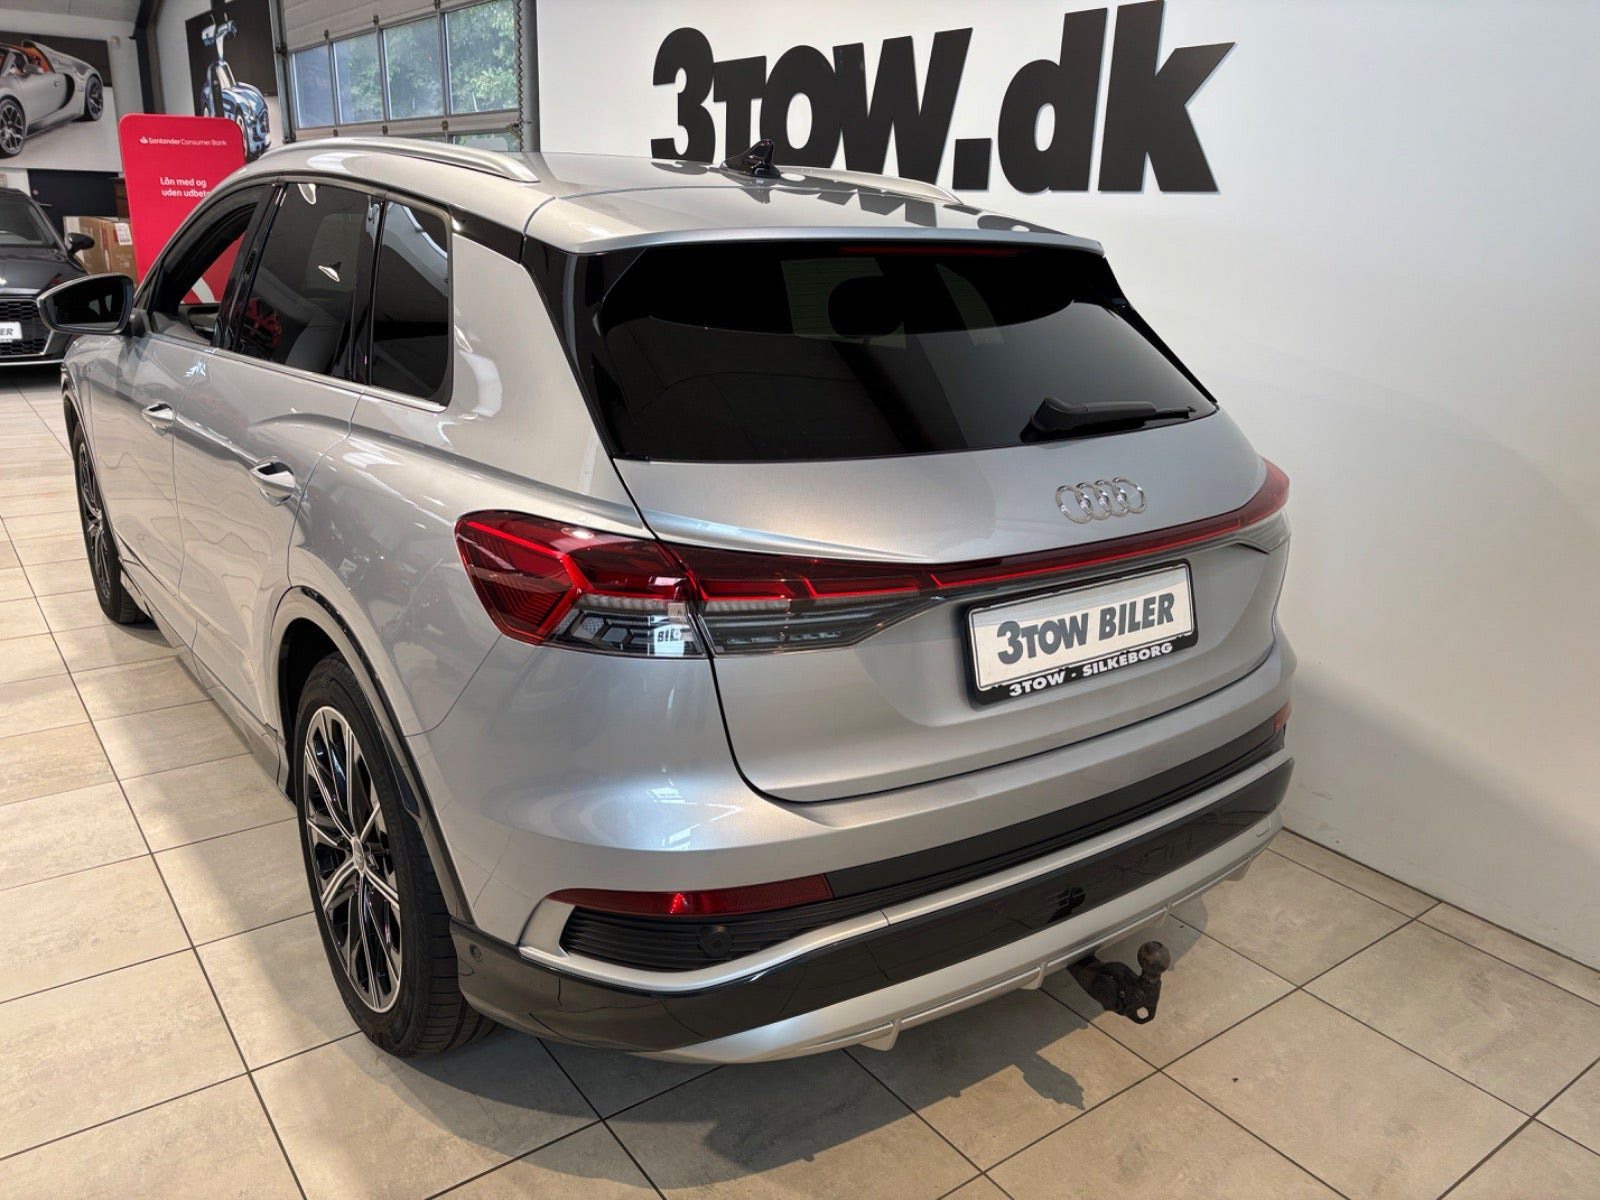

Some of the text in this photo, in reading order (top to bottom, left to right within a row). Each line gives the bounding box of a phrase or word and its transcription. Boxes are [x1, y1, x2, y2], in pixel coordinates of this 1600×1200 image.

[148, 137, 180, 145] Santander
[180, 138, 211, 146] Consumer
[159, 176, 207, 188] Lån med og
[161, 188, 183, 197] uden
[997, 592, 1175, 665] 3TOW BILER
[1009, 671, 1065, 697] 3TOW
[1082, 642, 1173, 677] SILKEBORG
